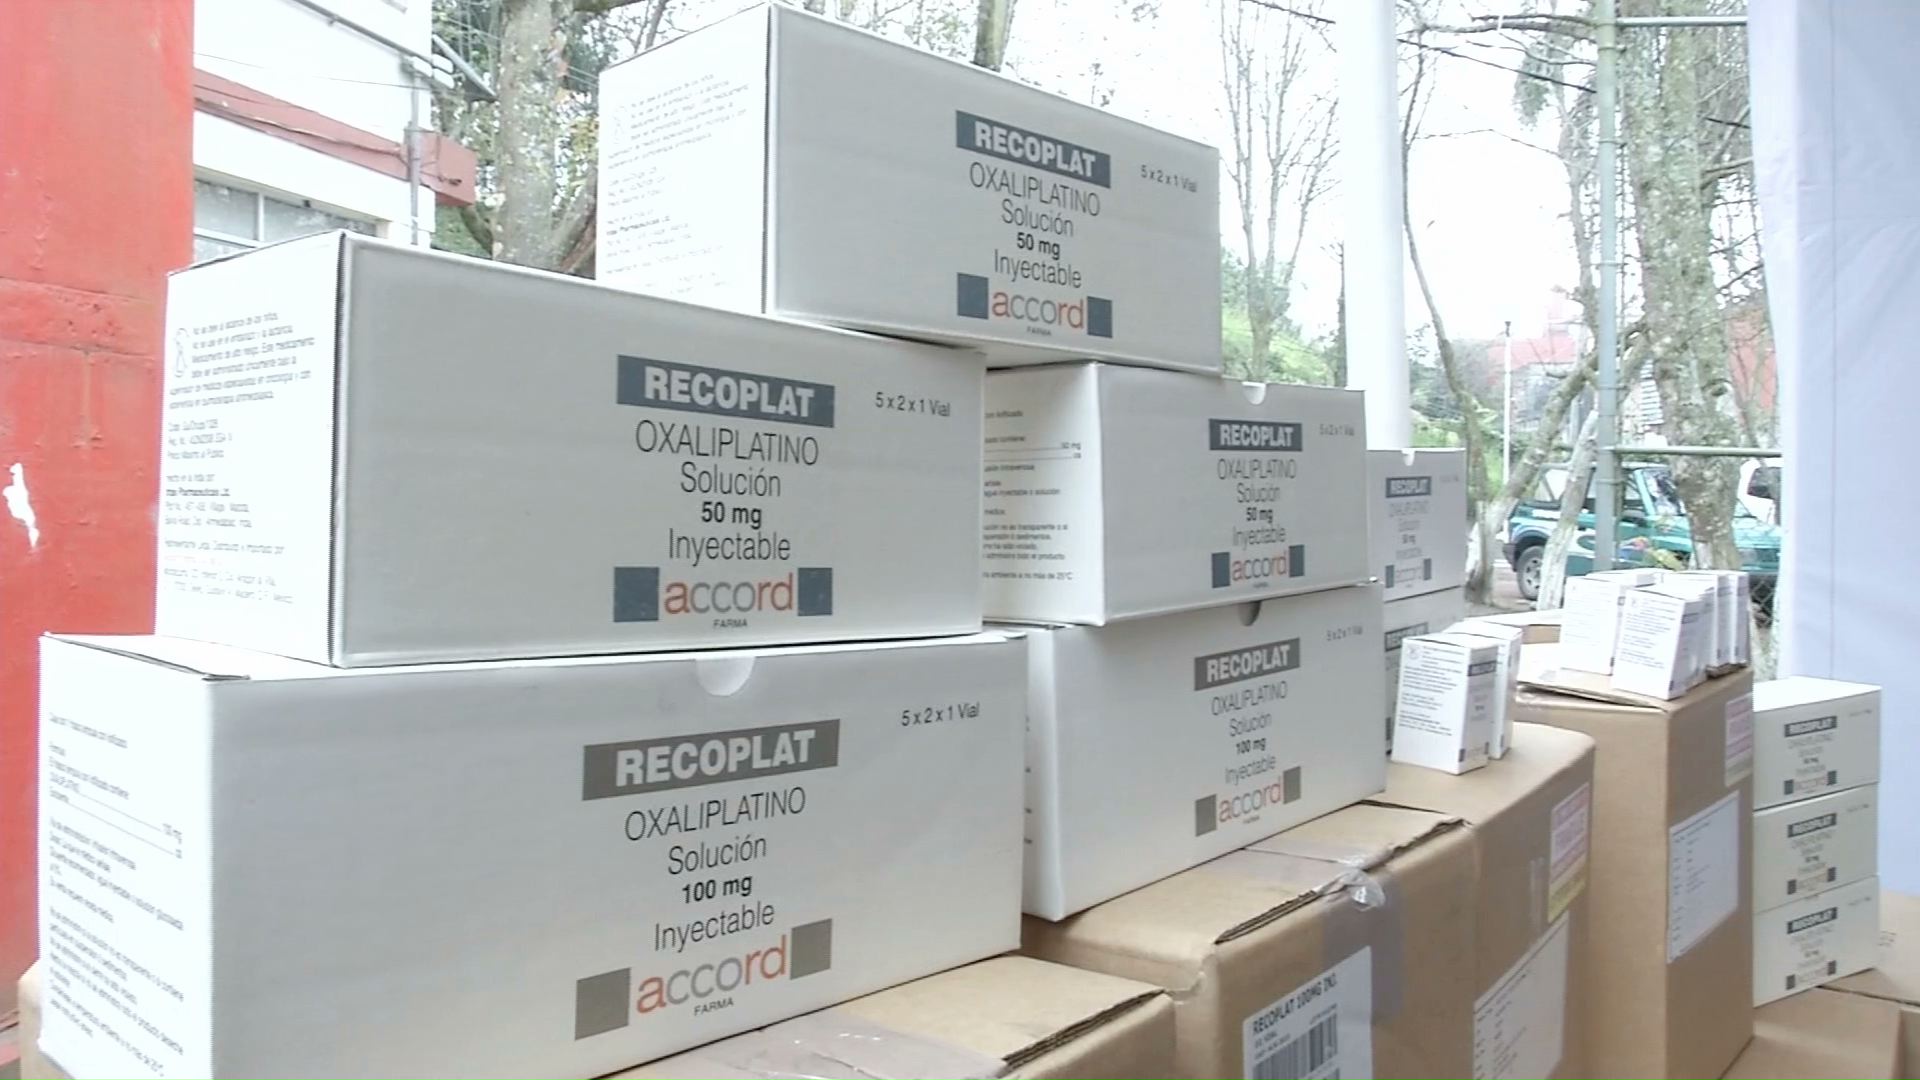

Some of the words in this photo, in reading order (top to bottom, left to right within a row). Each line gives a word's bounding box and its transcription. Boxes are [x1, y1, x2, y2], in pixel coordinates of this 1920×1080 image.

[974, 120, 1096, 177] RECOPLAT
[970, 162, 1100, 216] OXALIPLATINO
[1141, 165, 1147, 178] 5
[1157, 169, 1164, 182] 2
[1181, 176, 1198, 193] Vial
[1001, 198, 1074, 237] Solución
[1016, 232, 1034, 251] 50
[1039, 239, 1060, 260] mg
[994, 249, 1082, 288] Inyectable
[991, 291, 1084, 329] accord
[644, 365, 815, 418] RECOPLAT
[875, 392, 883, 409] 5
[897, 395, 906, 412] 2
[927, 398, 951, 418] Vial
[635, 419, 819, 466] OXALIPLATINO
[1220, 423, 1294, 447] RECOPLAT
[681, 461, 781, 497] Solución
[1217, 458, 1297, 480] OXALIPLATINO
[1236, 482, 1280, 503] Solución
[701, 502, 725, 524] 50
[732, 506, 762, 530] mg
[1246, 507, 1257, 522] 50
[1259, 508, 1274, 524] mg
[669, 527, 791, 567] Inyectable
[1232, 526, 1286, 550] Inyectable
[1232, 550, 1287, 581] accord
[664, 573, 794, 615] accord
[713, 618, 748, 630] FARMA
[1207, 645, 1291, 683] RECOPLAT
[901, 709, 910, 727] 5
[913, 712, 922, 725] x
[923, 707, 933, 724] 2
[935, 710, 944, 723] x
[946, 706, 953, 722] 1
[957, 702, 980, 720] Vial
[1211, 681, 1288, 716] OXALIPLATINO
[1229, 713, 1271, 737] Solución
[615, 729, 816, 787] RECOPLAT
[1236, 740, 1250, 754] 100
[1253, 738, 1266, 752] mg
[1225, 754, 1276, 785] Inyectable
[624, 786, 807, 842] OXALIPLATINO
[1219, 776, 1282, 823] accord
[668, 834, 767, 876] Solución
[681, 879, 716, 904] 100
[722, 875, 753, 898] mg
[654, 900, 775, 954] Inyectable
[636, 934, 788, 1015] accord
[693, 997, 734, 1017] FARMA
[1253, 998, 1295, 1034] RECOPLAT
